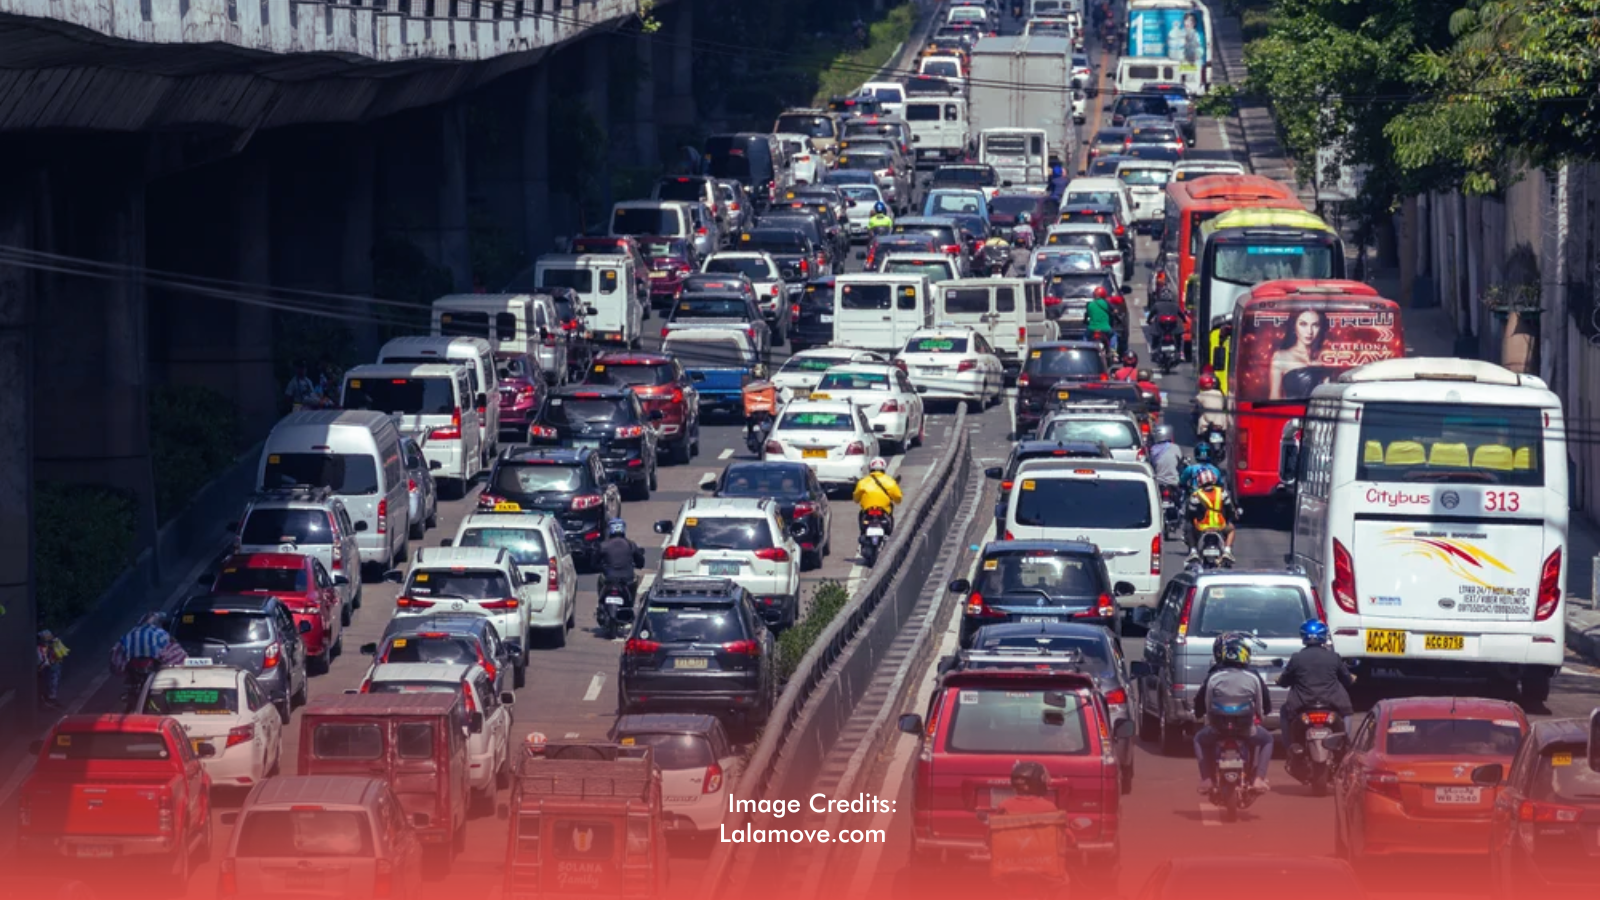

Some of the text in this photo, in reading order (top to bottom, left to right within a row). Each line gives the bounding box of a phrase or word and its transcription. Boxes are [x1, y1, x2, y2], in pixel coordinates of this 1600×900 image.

[1328, 342, 1388, 351] CATRIONA
[1366, 488, 1520, 512] Citybus 313
[557, 861, 603, 873] SOLANA
[556, 872, 599, 890] Family
